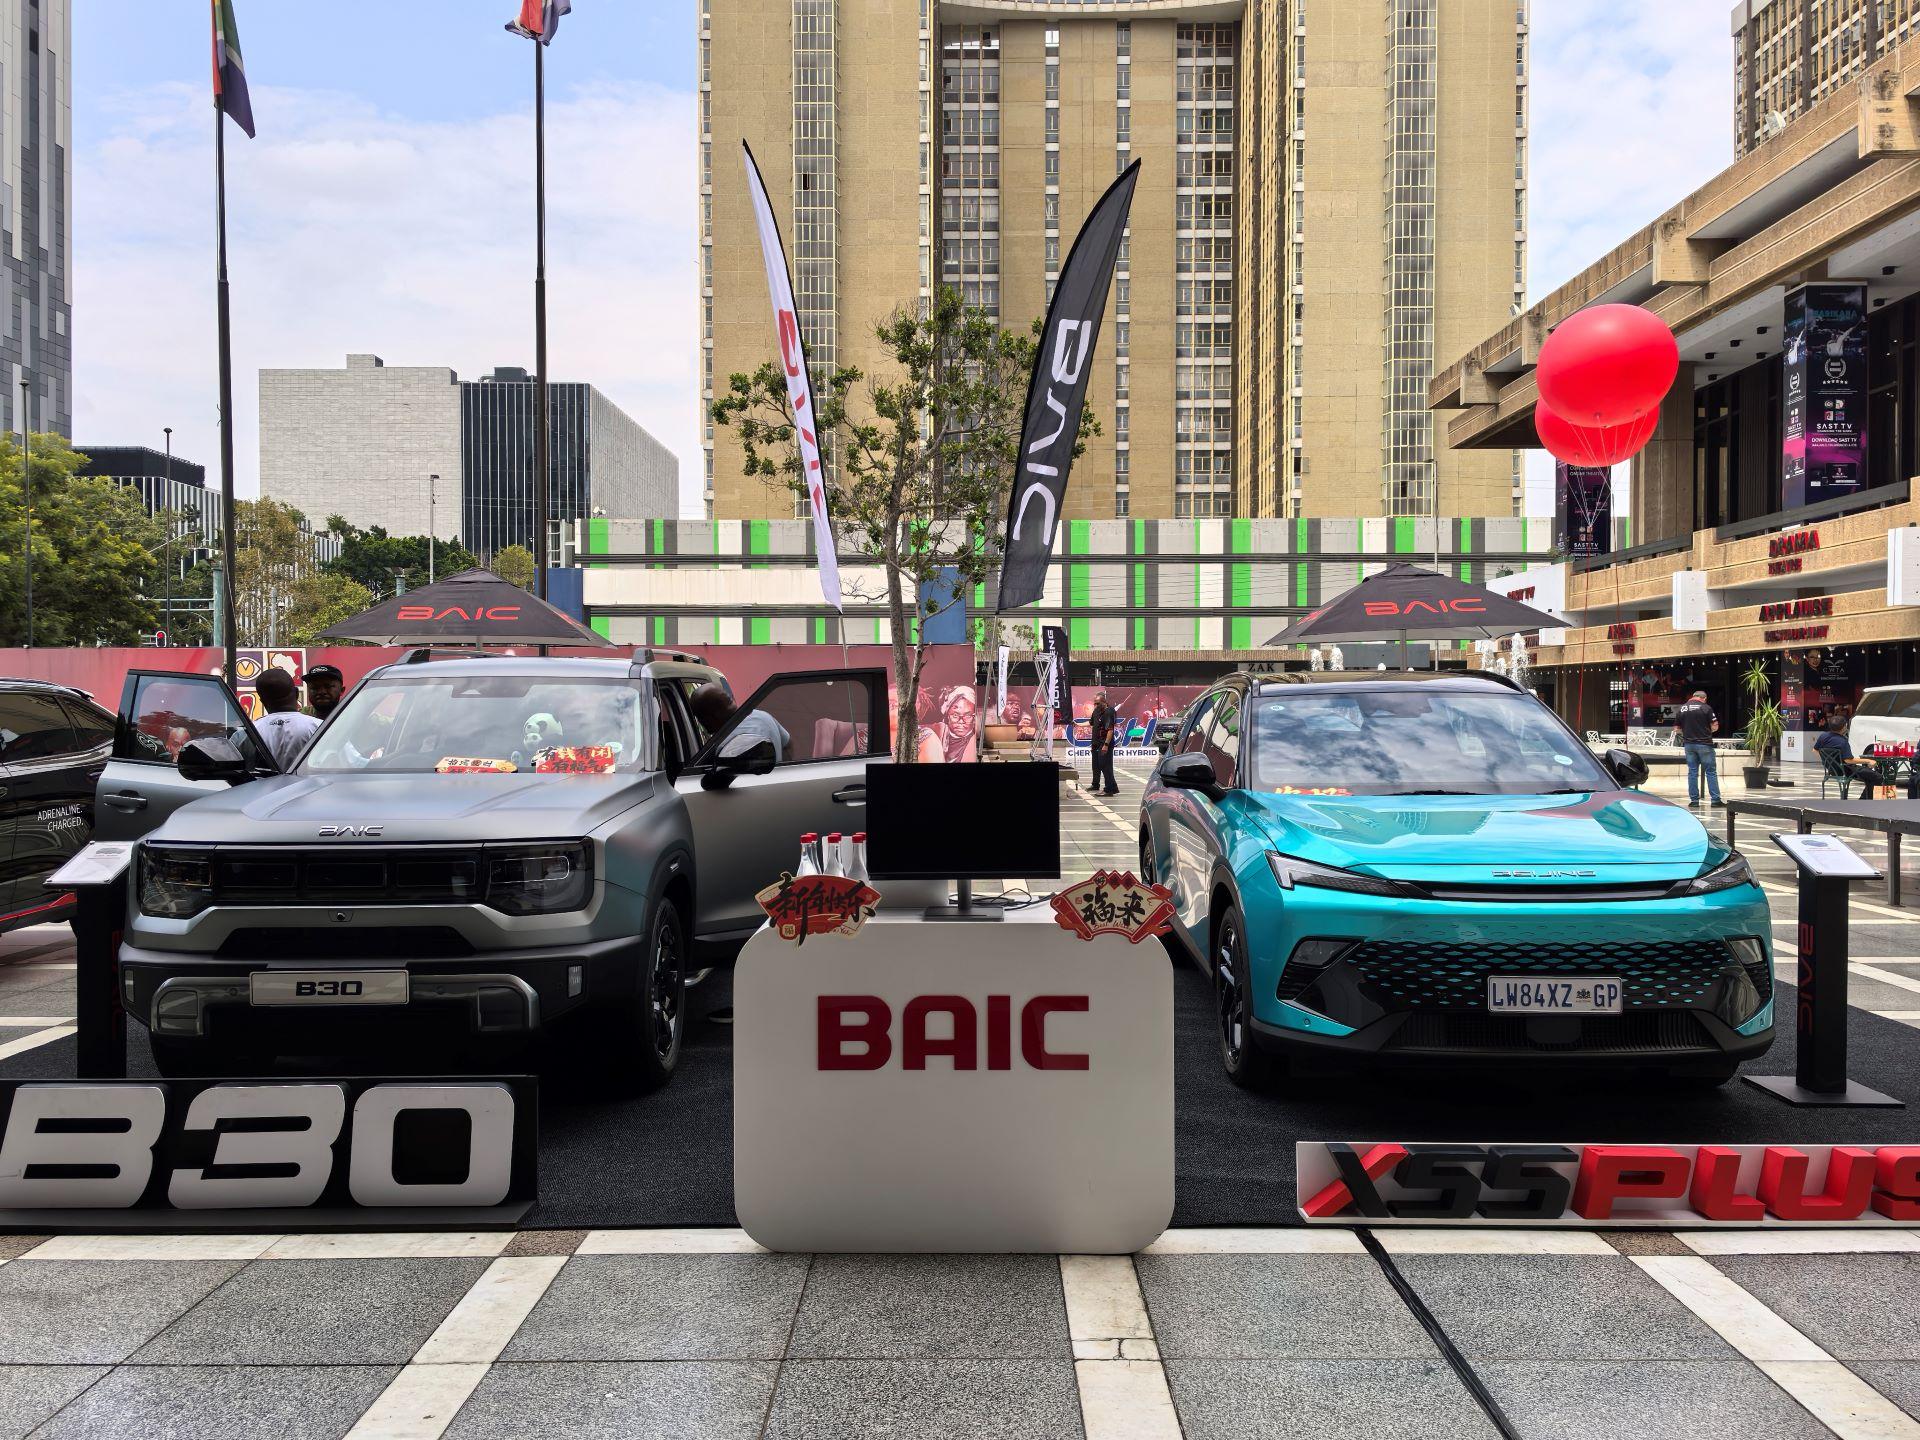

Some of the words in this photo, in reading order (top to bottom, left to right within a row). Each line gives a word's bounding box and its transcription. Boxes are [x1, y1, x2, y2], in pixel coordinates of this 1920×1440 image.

[1013, 318, 1092, 546] BAIC
[397, 606, 521, 621] BAIC
[1363, 598, 1486, 616] BAIC
[1248, 663, 1275, 672] ZAK
[1126, 749, 1158, 757] HYBRID
[37, 803, 83, 821] ADRENALINE.
[47, 816, 84, 832] CHARGED.
[319, 825, 384, 837] BAIC
[295, 980, 363, 996] B30
[1593, 983, 1618, 1008] GP
[817, 995, 1090, 1071] BAIC
[0, 1083, 516, 1209] B30
